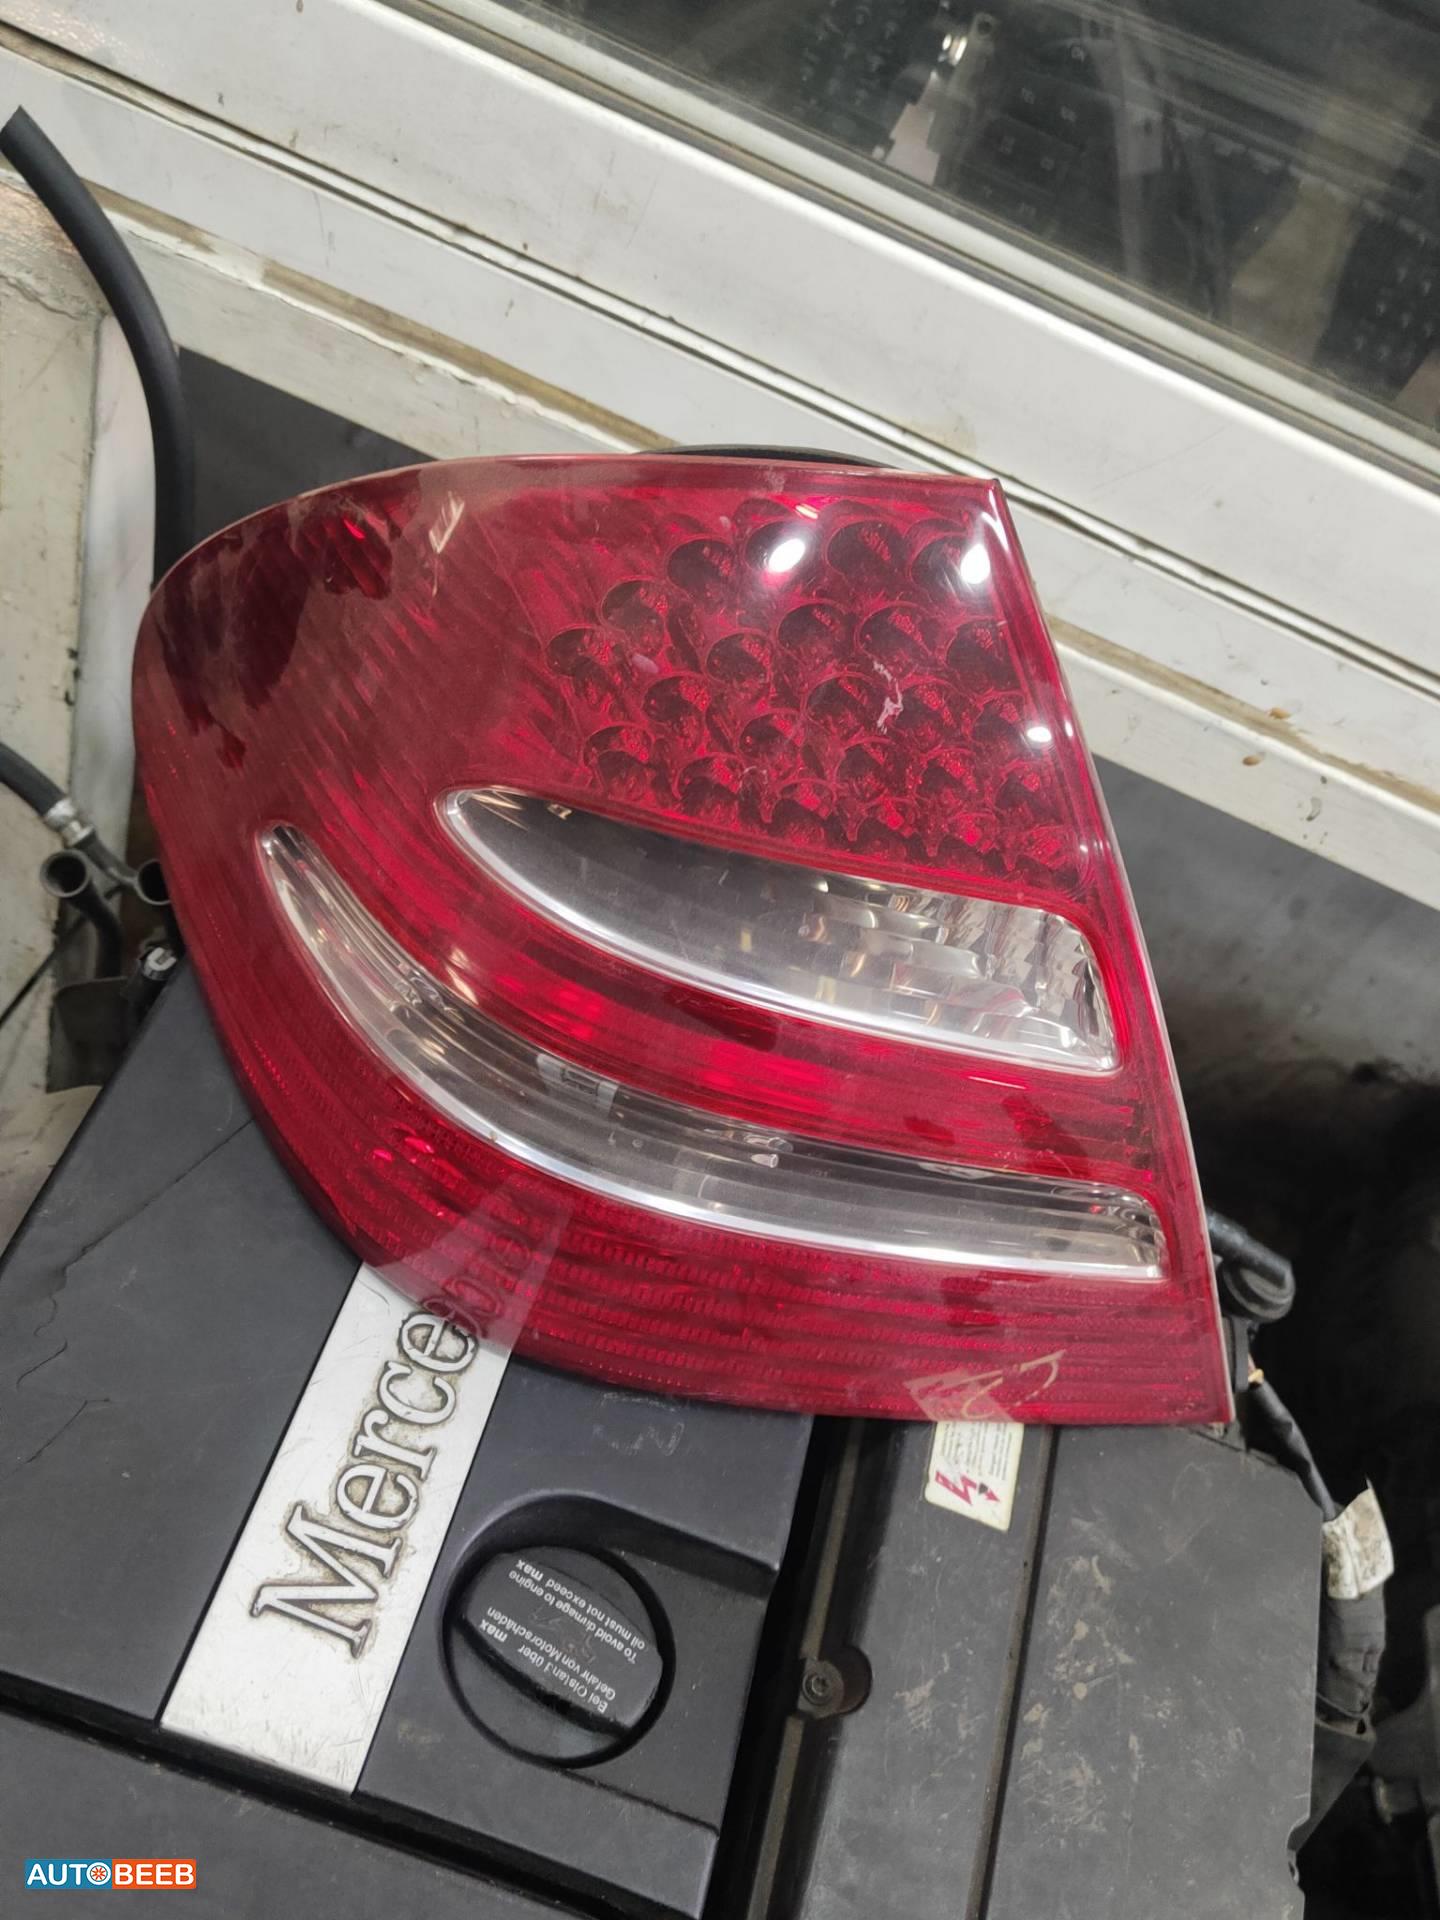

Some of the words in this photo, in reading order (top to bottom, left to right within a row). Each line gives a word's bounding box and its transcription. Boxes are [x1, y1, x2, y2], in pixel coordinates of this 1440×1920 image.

[515, 1559, 544, 1582] max
[508, 1569, 545, 1597] engine
[544, 1578, 587, 1609] exceed
[543, 1592, 556, 1606] to
[585, 1603, 606, 1622] not
[479, 1618, 508, 1643] max
[486, 1606, 562, 1661] Motorschäden
[593, 1626, 625, 1652] avoid
[603, 1616, 633, 1641] must
[629, 1635, 646, 1651] oil
[560, 1654, 581, 1674] von
[624, 1646, 637, 1665] To
[580, 1669, 617, 1701] Gefahr
[587, 1691, 609, 1714] Bei
